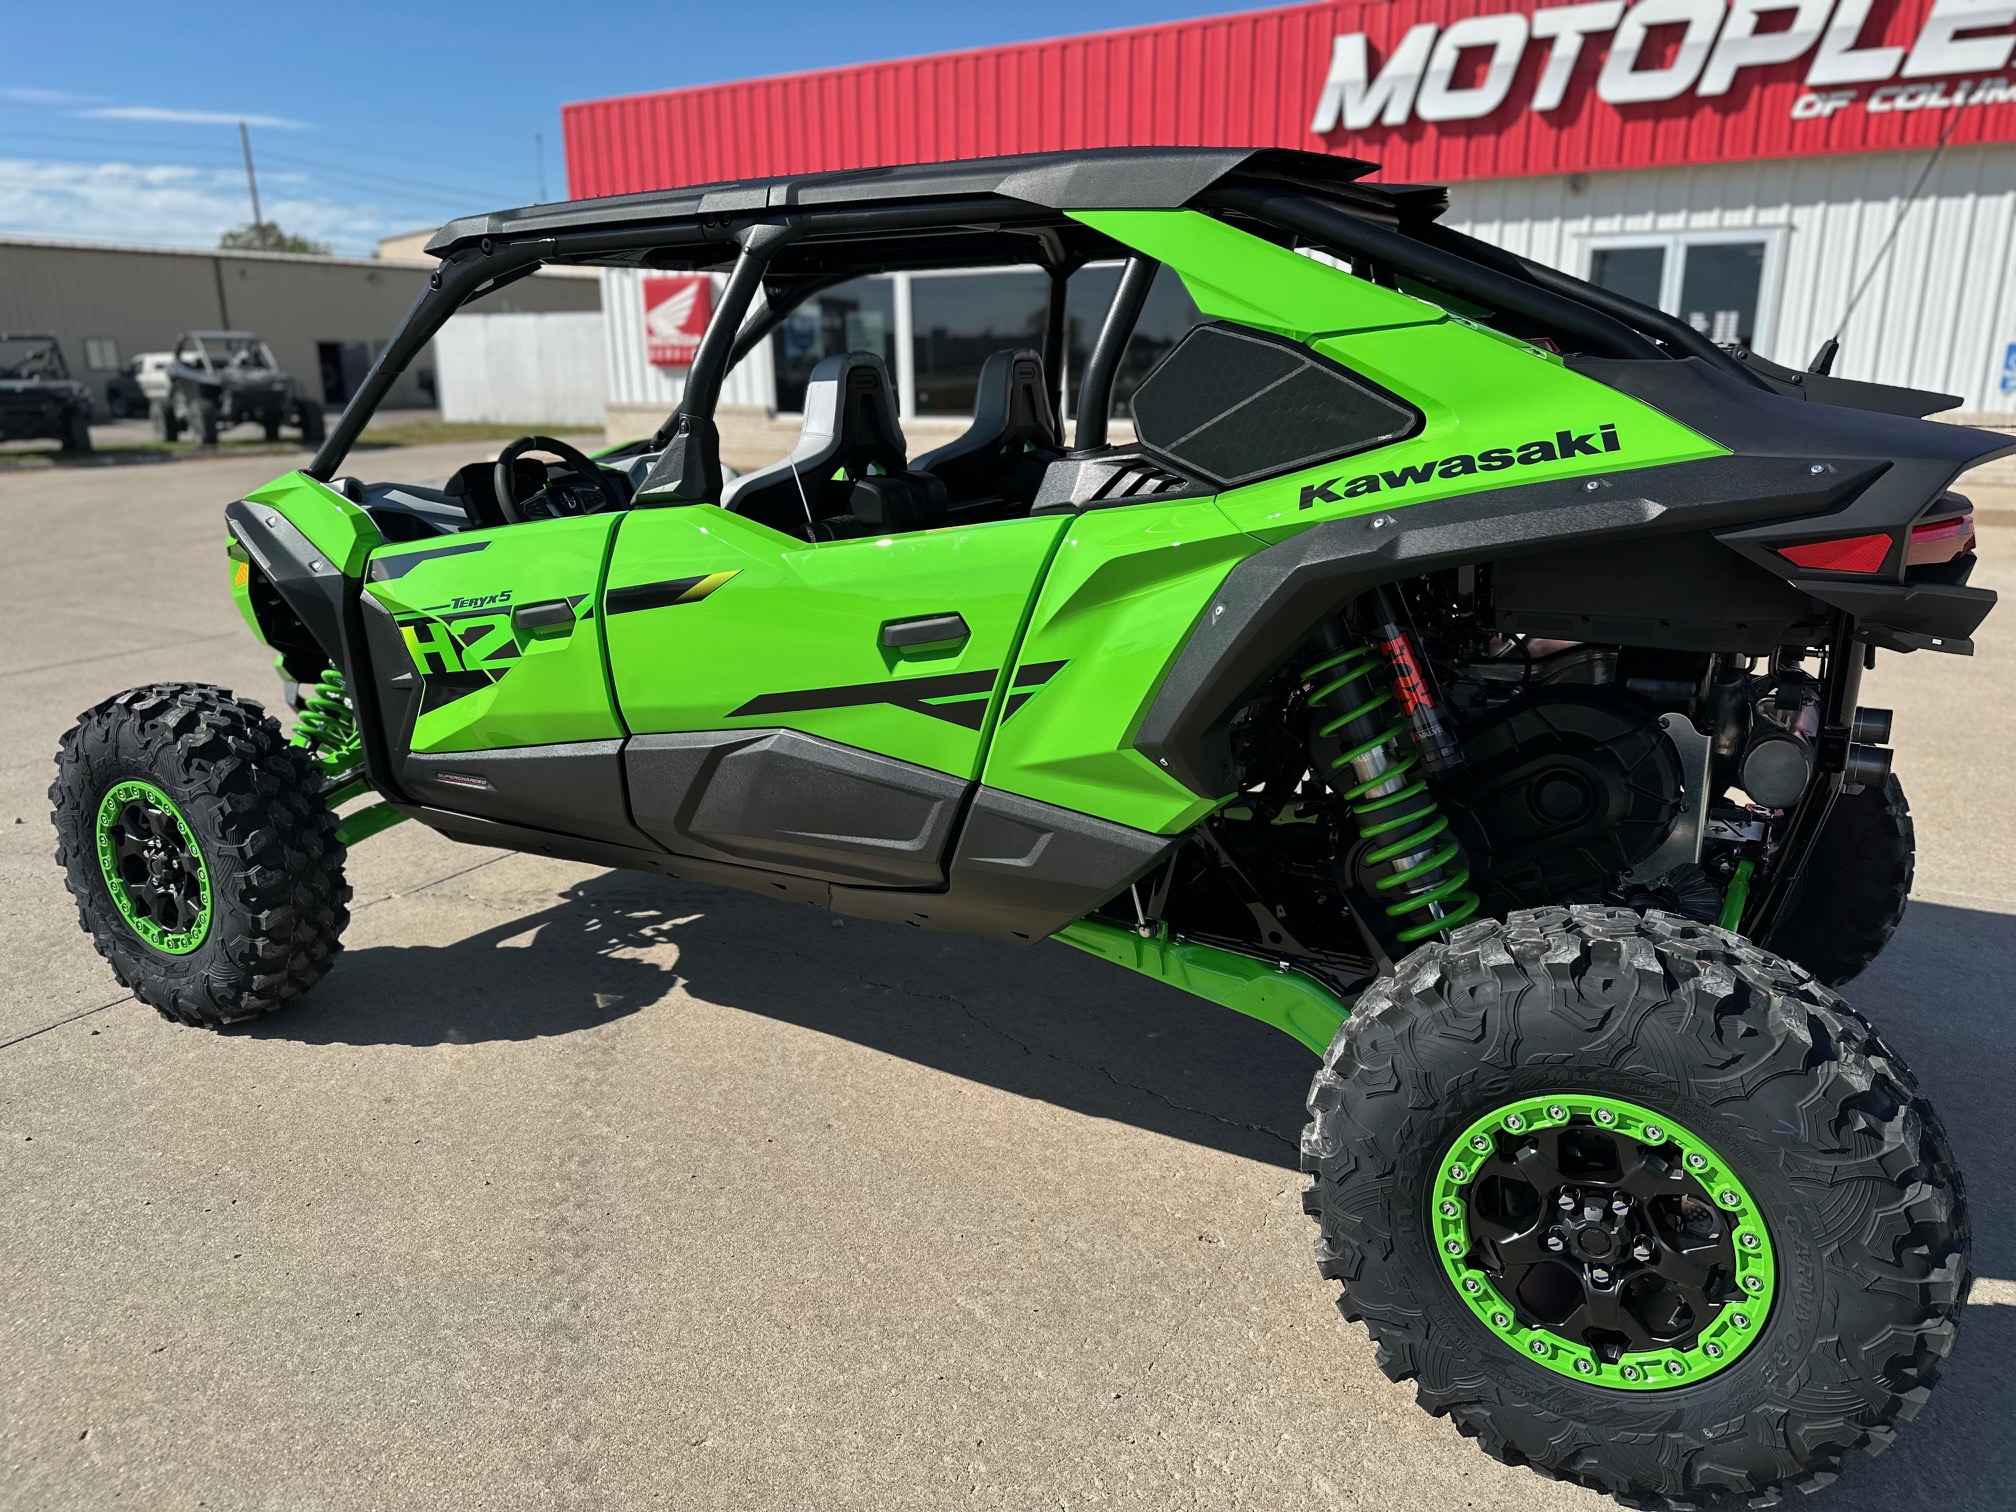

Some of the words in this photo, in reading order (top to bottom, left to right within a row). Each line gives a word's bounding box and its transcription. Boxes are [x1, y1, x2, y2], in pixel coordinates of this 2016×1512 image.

[1311, 0, 2016, 133] MOTOPLE
[1791, 89, 1858, 120] OF
[1299, 423, 1621, 510] Kawasaki
[400, 613, 522, 675] H2
[1379, 632, 1436, 718] FOX
